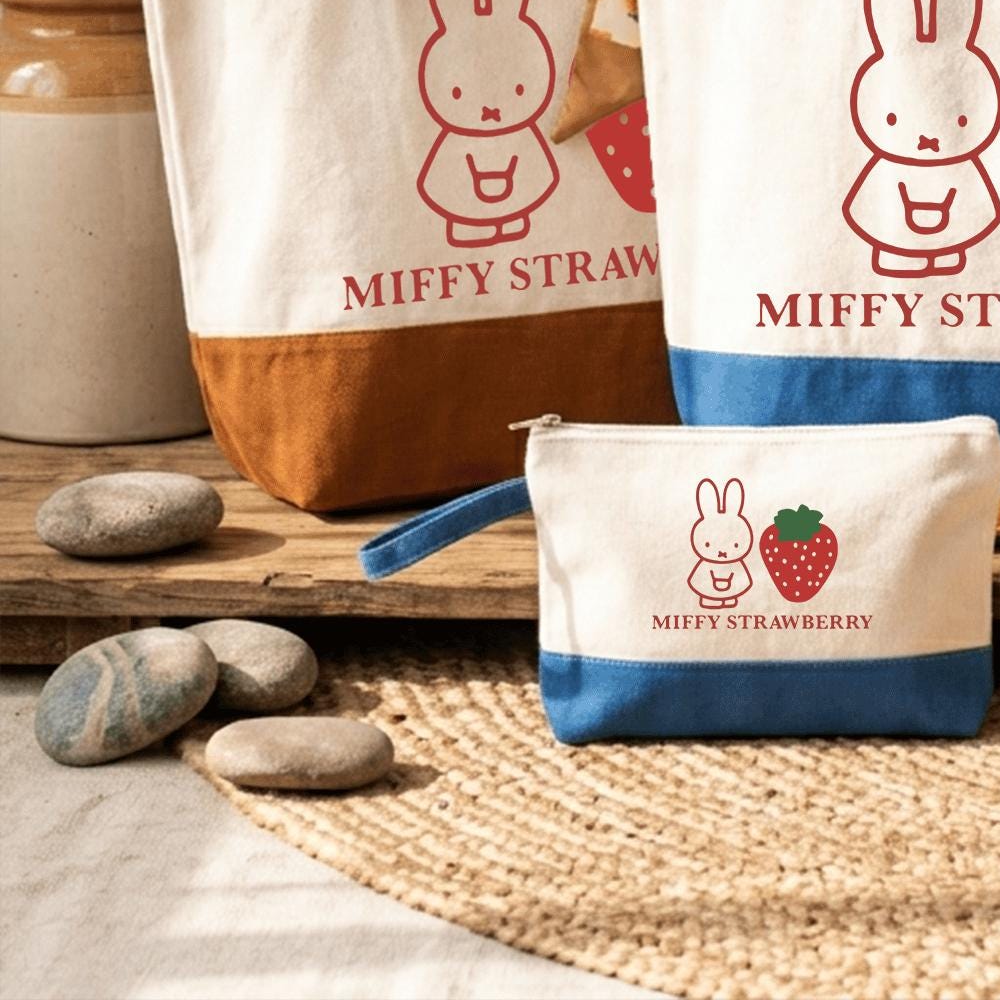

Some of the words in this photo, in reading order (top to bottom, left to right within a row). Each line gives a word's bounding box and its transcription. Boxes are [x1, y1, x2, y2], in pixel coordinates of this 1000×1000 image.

[343, 260, 495, 311] MIFFY
[757, 292, 924, 328] MIFFY
[652, 614, 721, 630] MIFFY
[727, 614, 873, 630] STRAWBERRY
